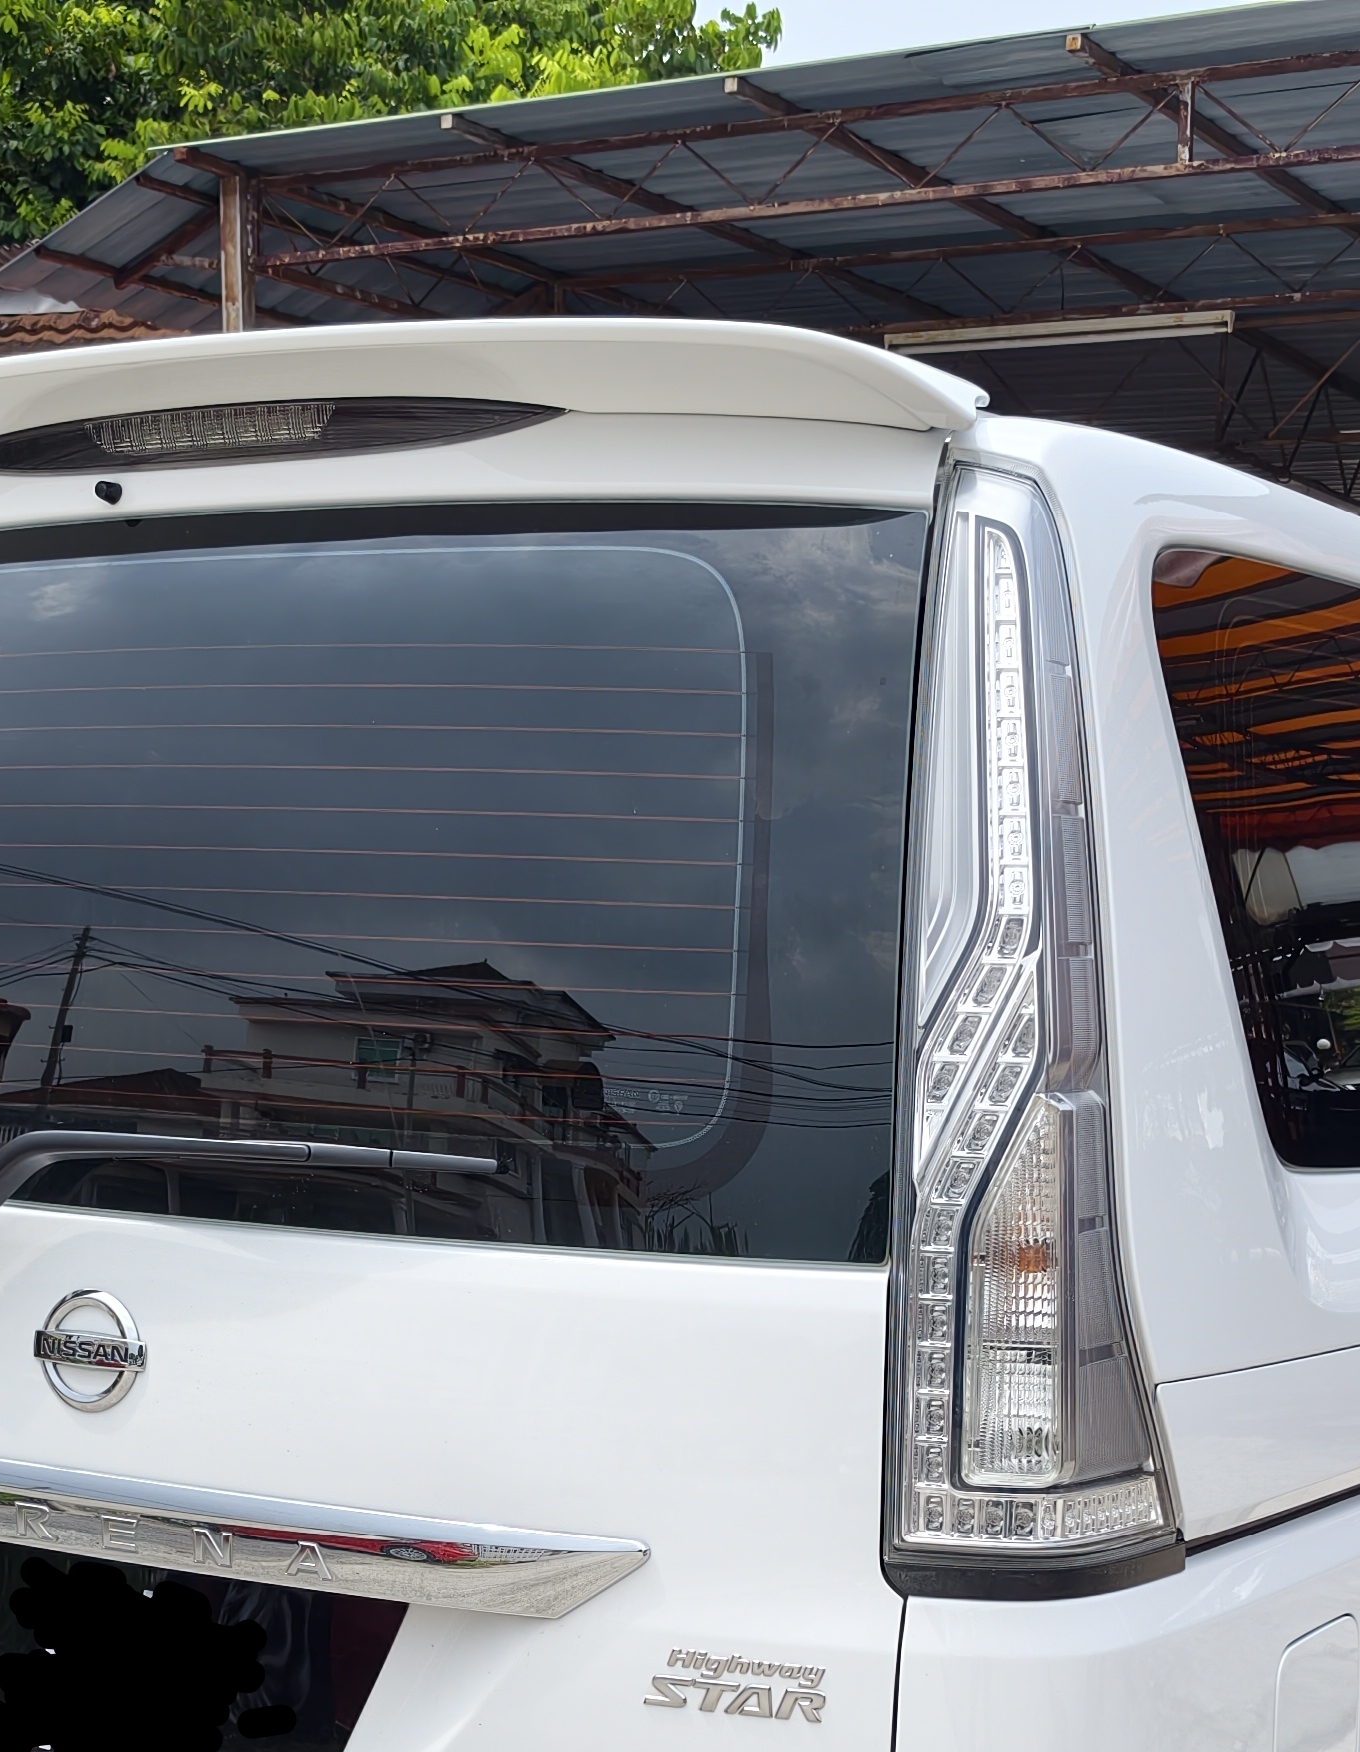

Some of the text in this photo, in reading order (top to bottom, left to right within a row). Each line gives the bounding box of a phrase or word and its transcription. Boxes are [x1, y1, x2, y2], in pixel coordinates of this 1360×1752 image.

[40, 1336, 129, 1365] NISSAN
[667, 1647, 826, 1689] Highway
[643, 1674, 827, 1724] STAR
